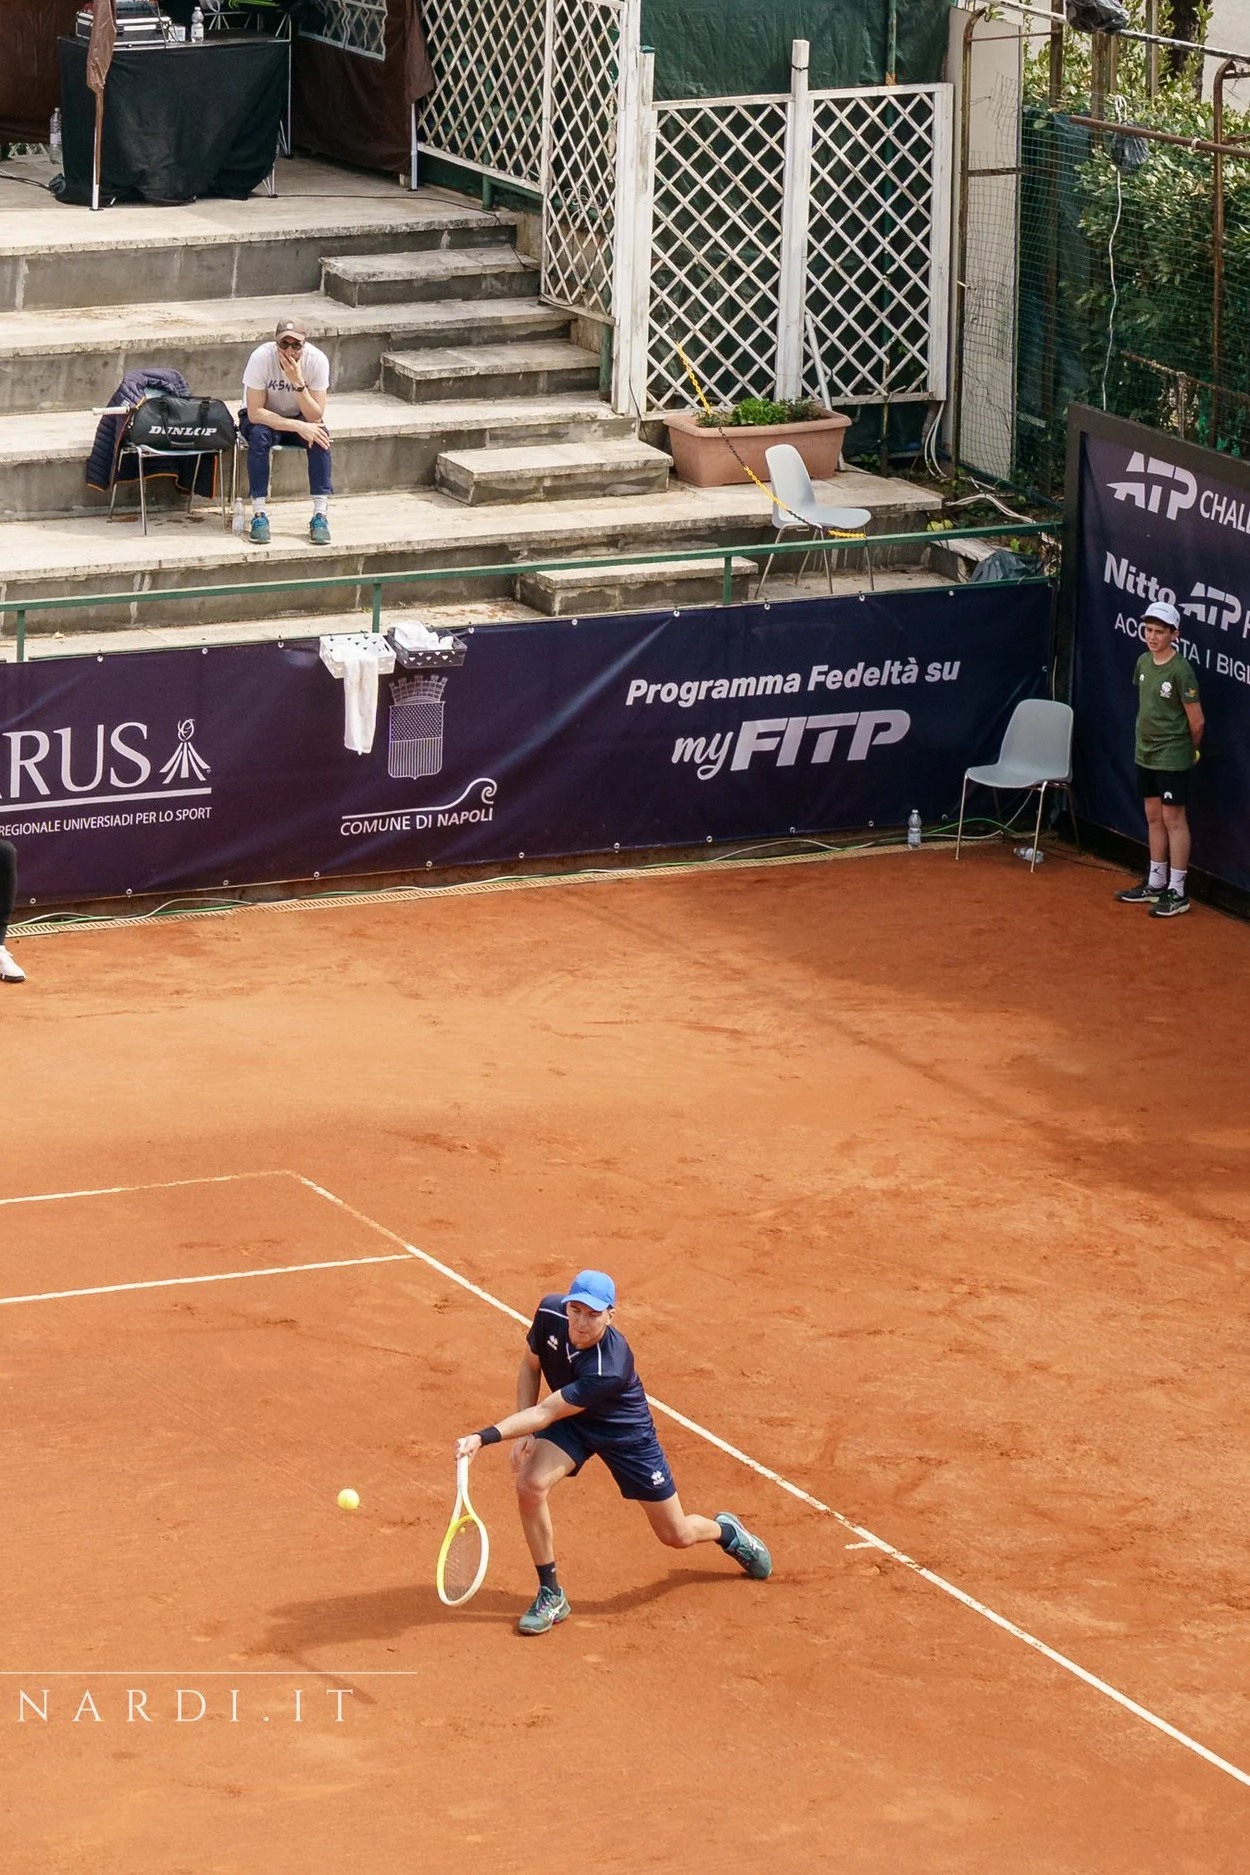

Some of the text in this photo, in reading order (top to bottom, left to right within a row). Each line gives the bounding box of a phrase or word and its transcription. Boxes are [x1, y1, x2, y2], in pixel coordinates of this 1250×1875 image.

[148, 425, 217, 437] DUNLOP
[1106, 451, 1198, 521] ATP
[1103, 551, 1176, 606] Nitto
[1178, 581, 1242, 632] ATP
[625, 657, 961, 707] Programma Fedeltà su
[63, 814, 133, 832] UNIVERSIADI
[136, 811, 157, 826] PER
[159, 809, 174, 823] LO
[175, 807, 213, 822] SPORT
[340, 807, 493, 836] COMUNE DI NAPOLI
